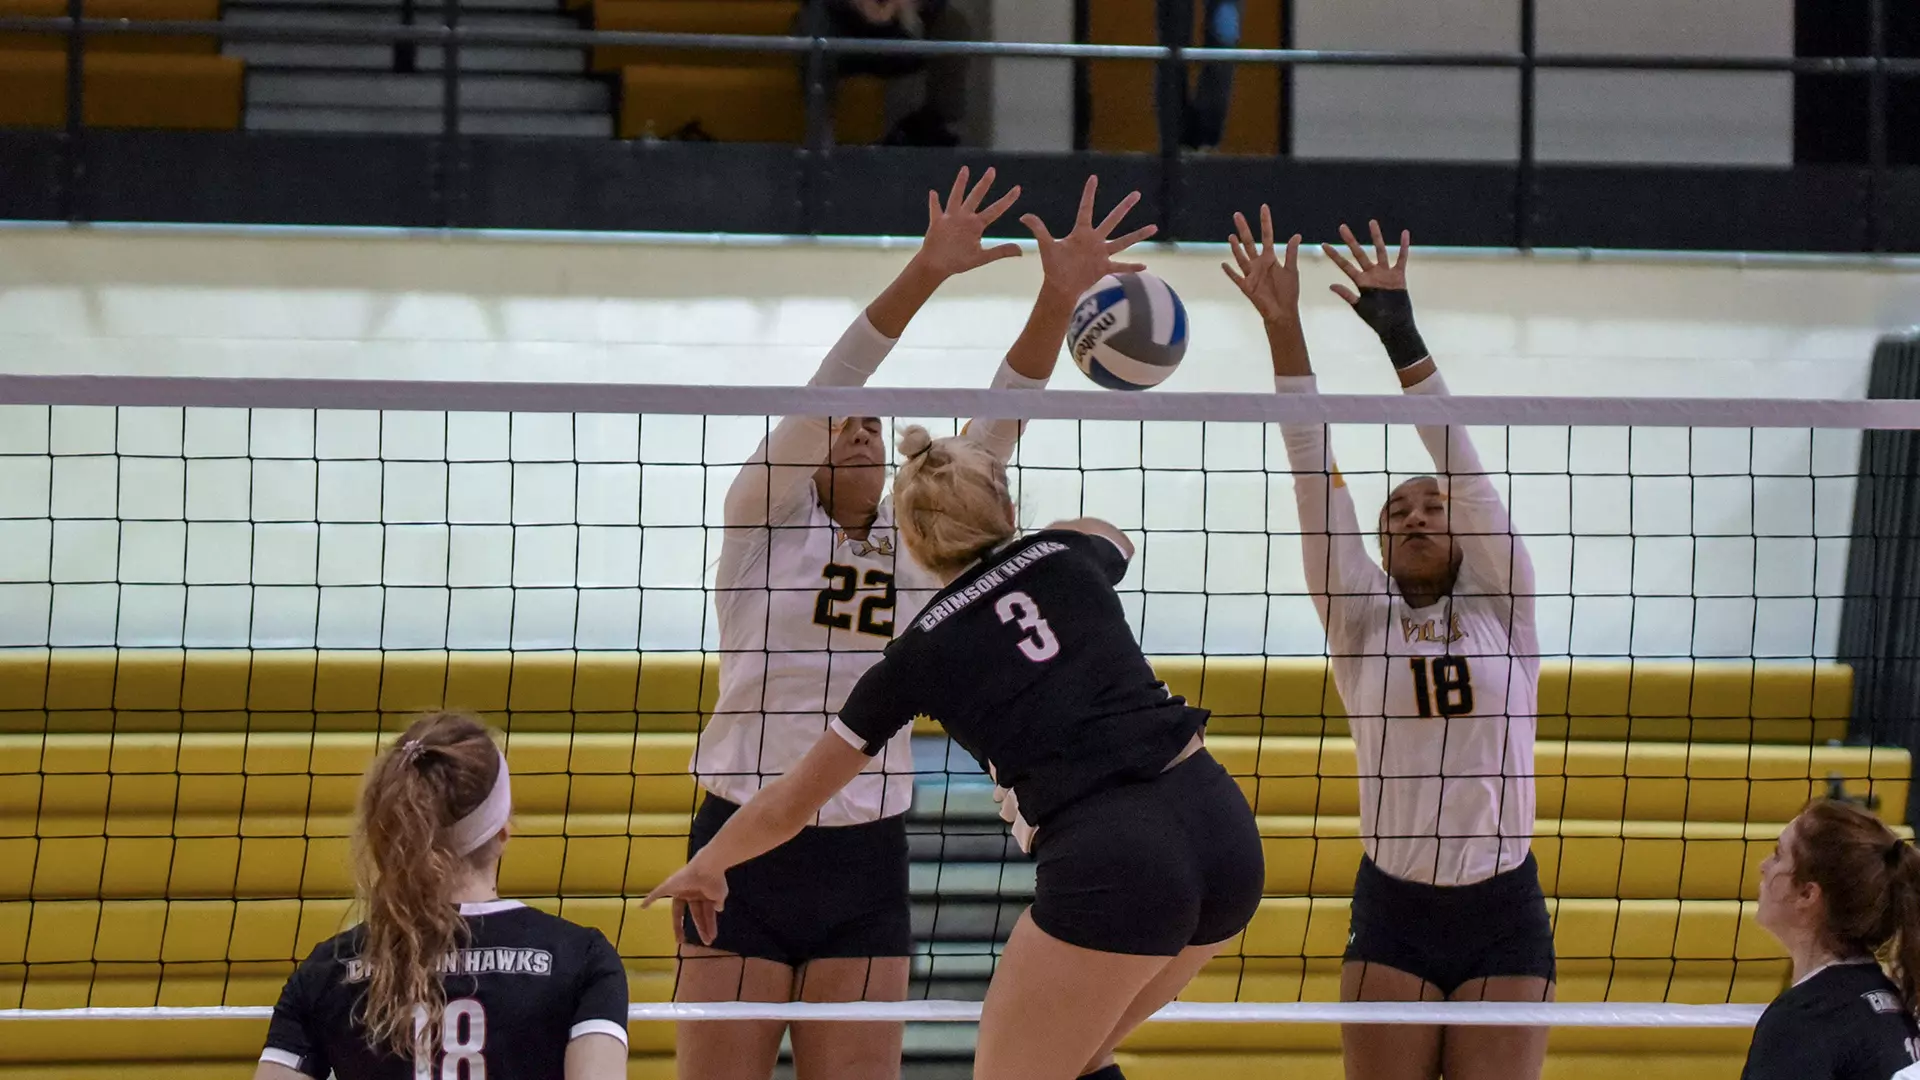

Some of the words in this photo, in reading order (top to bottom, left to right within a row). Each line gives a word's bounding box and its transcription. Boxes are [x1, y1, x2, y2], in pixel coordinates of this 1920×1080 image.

[813, 562, 896, 639] 22
[919, 569, 1006, 632] CRIMSON
[1000, 541, 1067, 577] HAWKS
[994, 590, 1061, 663] 3
[1409, 656, 1476, 719] 18
[464, 949, 550, 973] HAWKS
[411, 998, 488, 1080] 18
